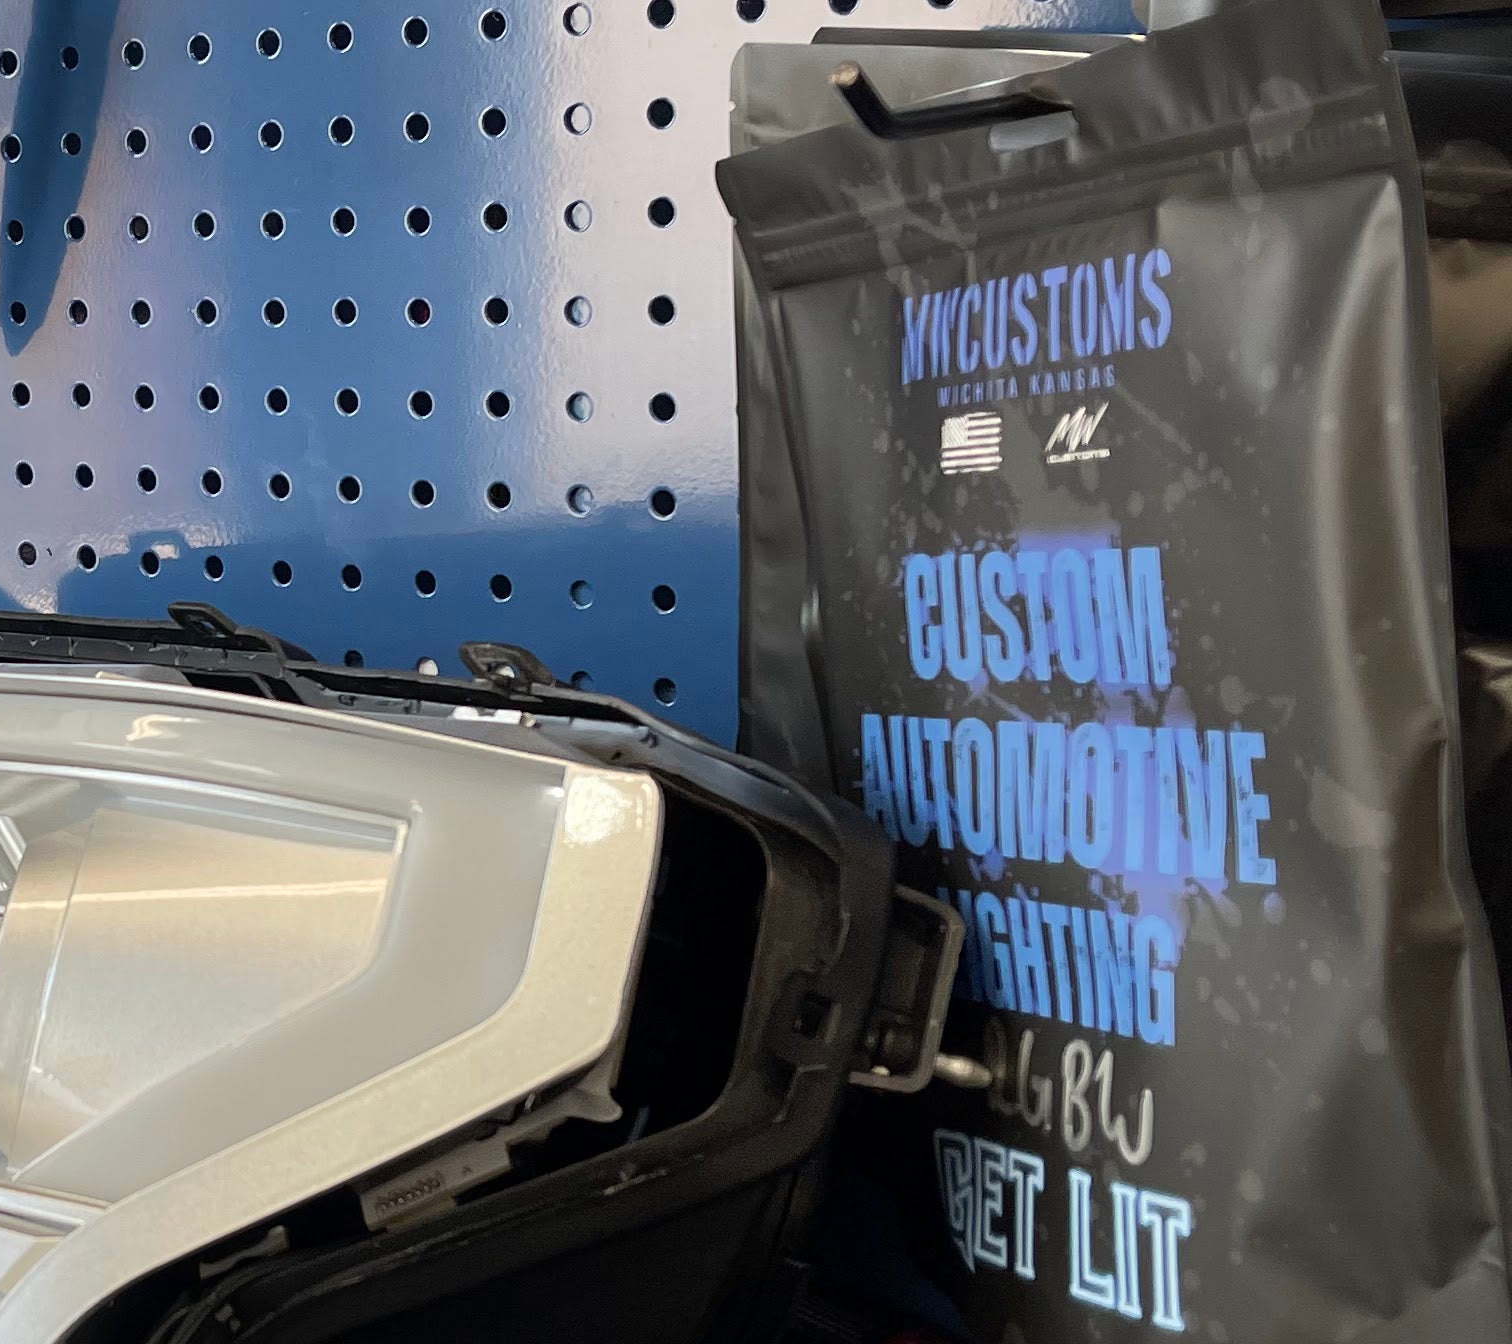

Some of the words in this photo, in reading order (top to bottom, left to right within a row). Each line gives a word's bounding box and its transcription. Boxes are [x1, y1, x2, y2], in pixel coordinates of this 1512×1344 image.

[901, 248, 1172, 385] MWCUSTOMS
[938, 377, 1020, 407] WICHITA
[1029, 364, 1116, 396] KANSAS
[904, 545, 1173, 690] CUSTOM
[861, 713, 1278, 885] AUTOMOTIVE
[933, 1128, 1045, 1281] GET
[1068, 1168, 1192, 1333] LIT
